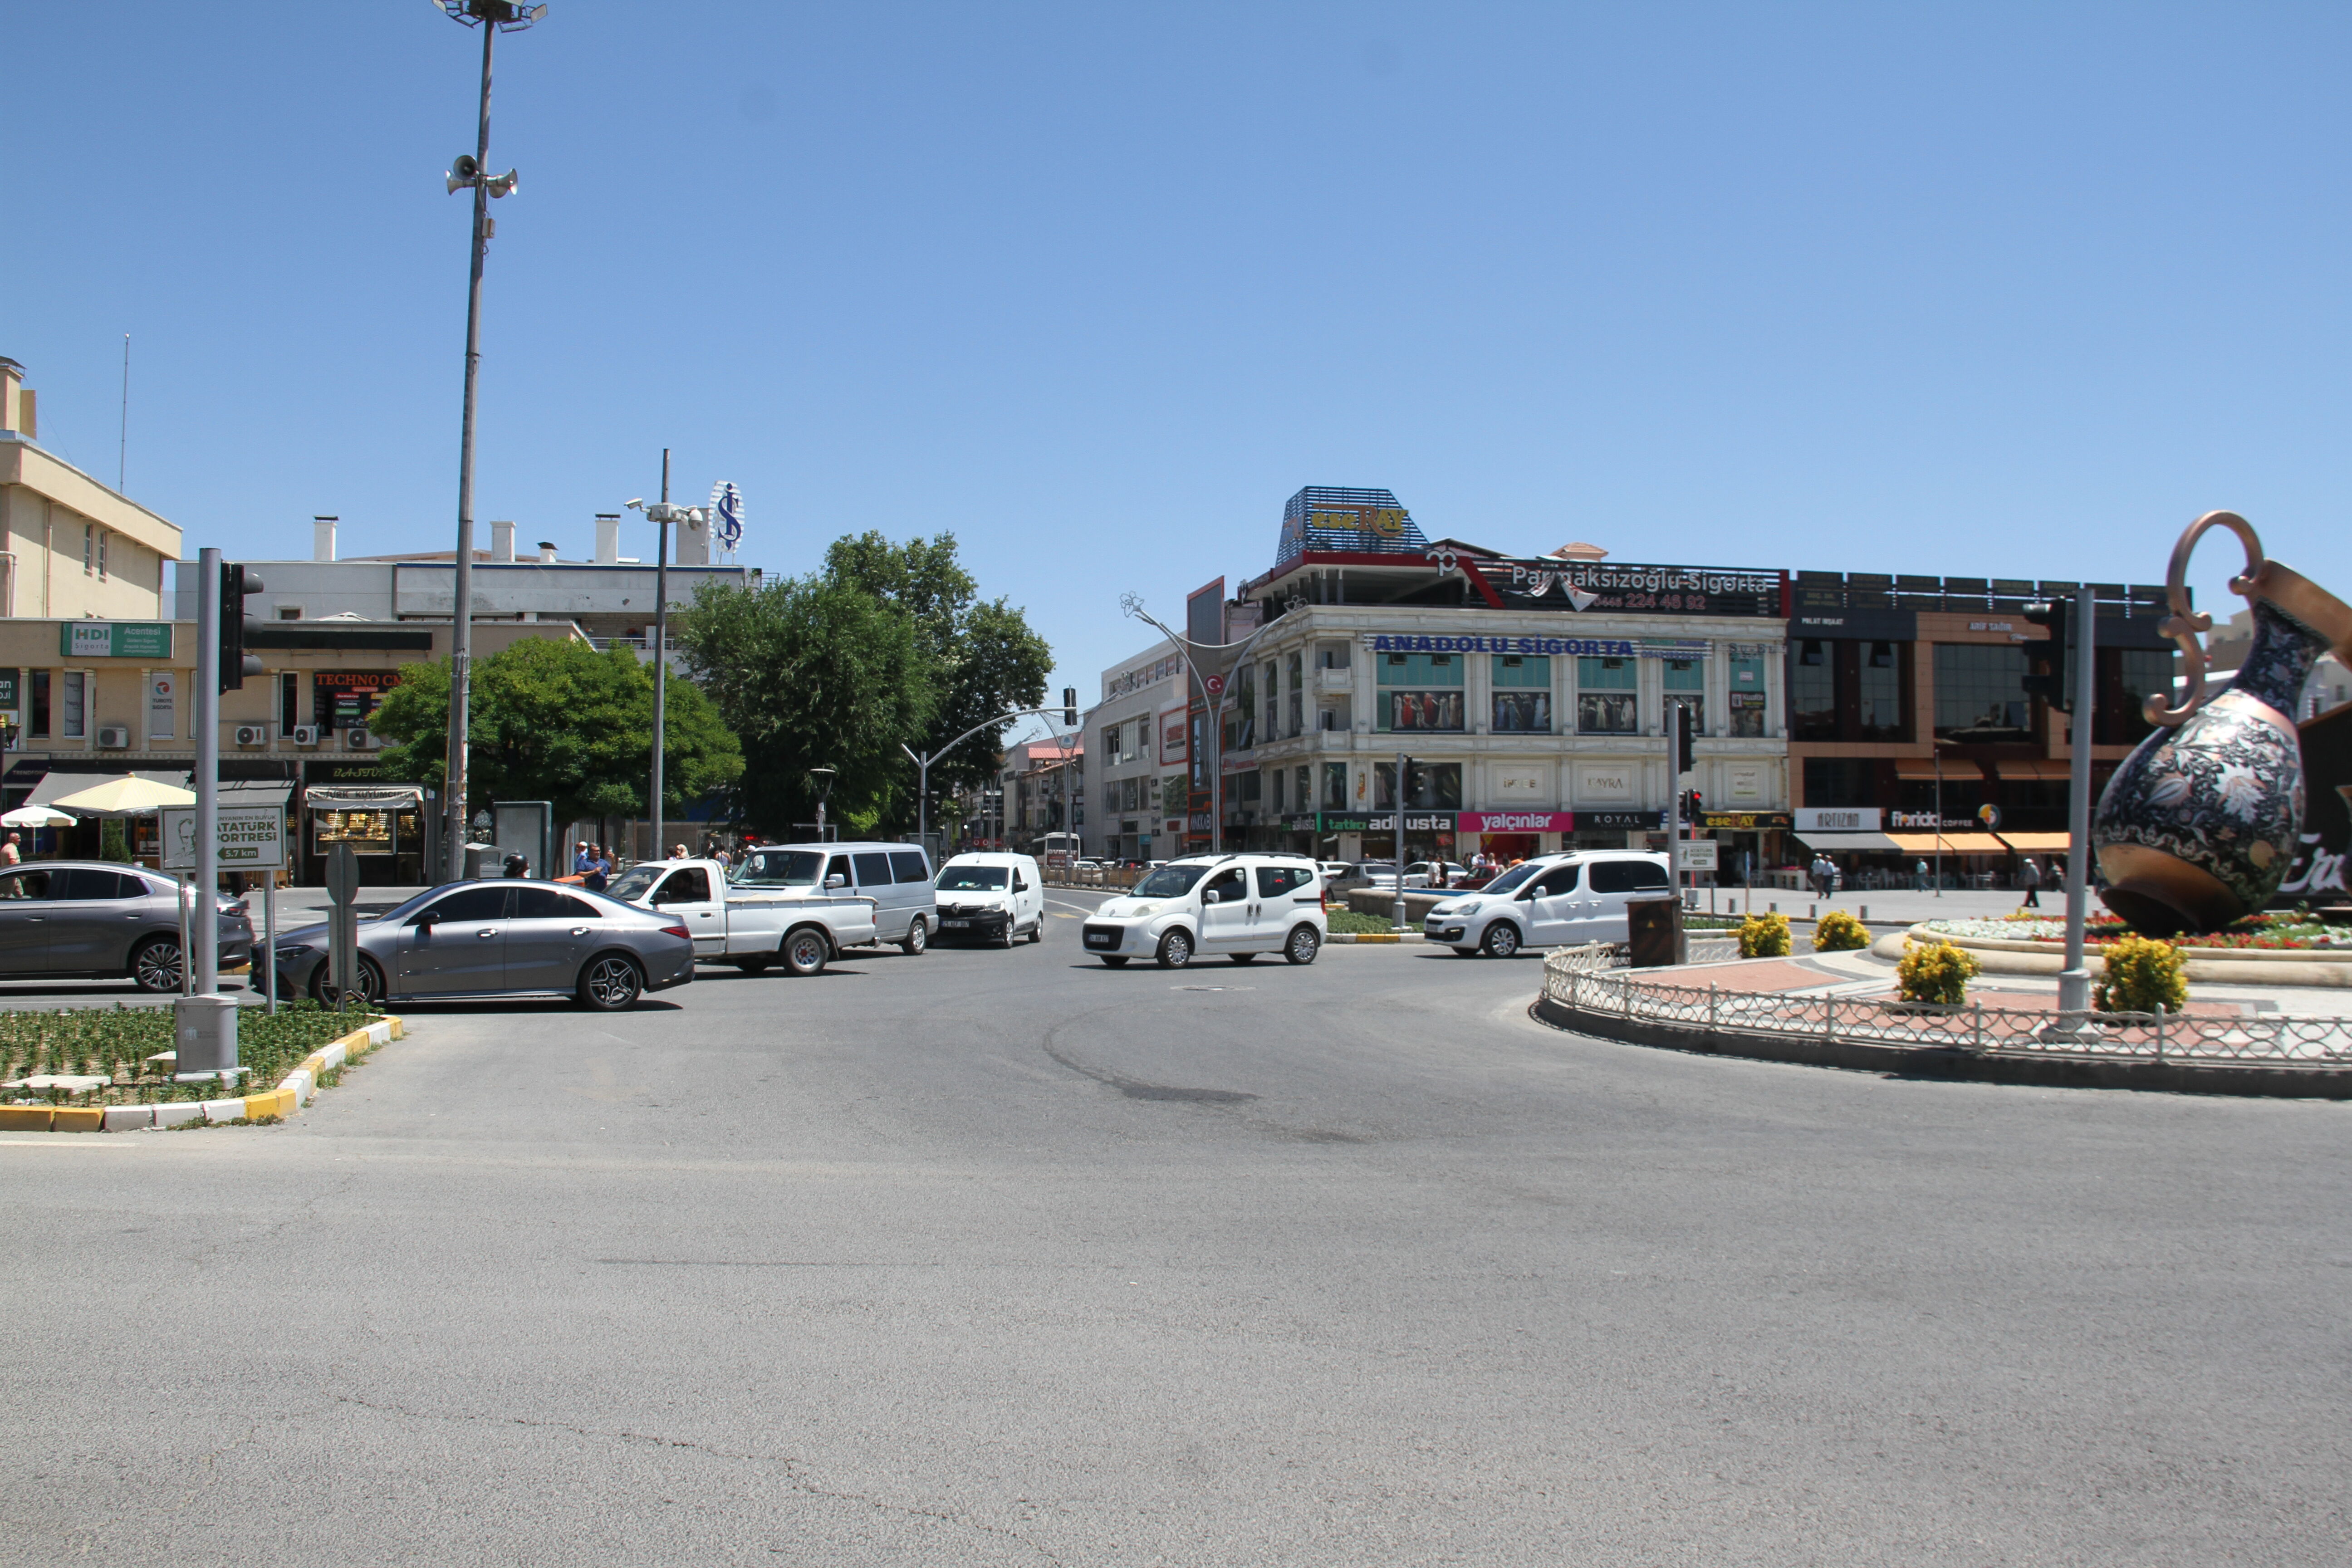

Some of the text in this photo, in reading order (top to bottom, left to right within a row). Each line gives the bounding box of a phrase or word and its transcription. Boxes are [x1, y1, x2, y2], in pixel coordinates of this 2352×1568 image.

[1688, 571, 1768, 594] Sigorta
[1626, 593, 1655, 608] 224
[1660, 595, 1681, 609] 46
[1686, 595, 1705, 610] 92
[75, 629, 109, 640] HDI
[124, 627, 161, 635] Acentesi
[1373, 635, 1509, 652] ANADOLU
[1518, 634, 1633, 655] SİGORTA
[315, 674, 379, 686] TECHNO
[333, 767, 380, 777] BASTÜ
[1369, 815, 1397, 830] adi
[1406, 815, 1450, 830] usta
[1481, 813, 1552, 832] yalçınlar
[217, 832, 277, 842] ORTRESİ
